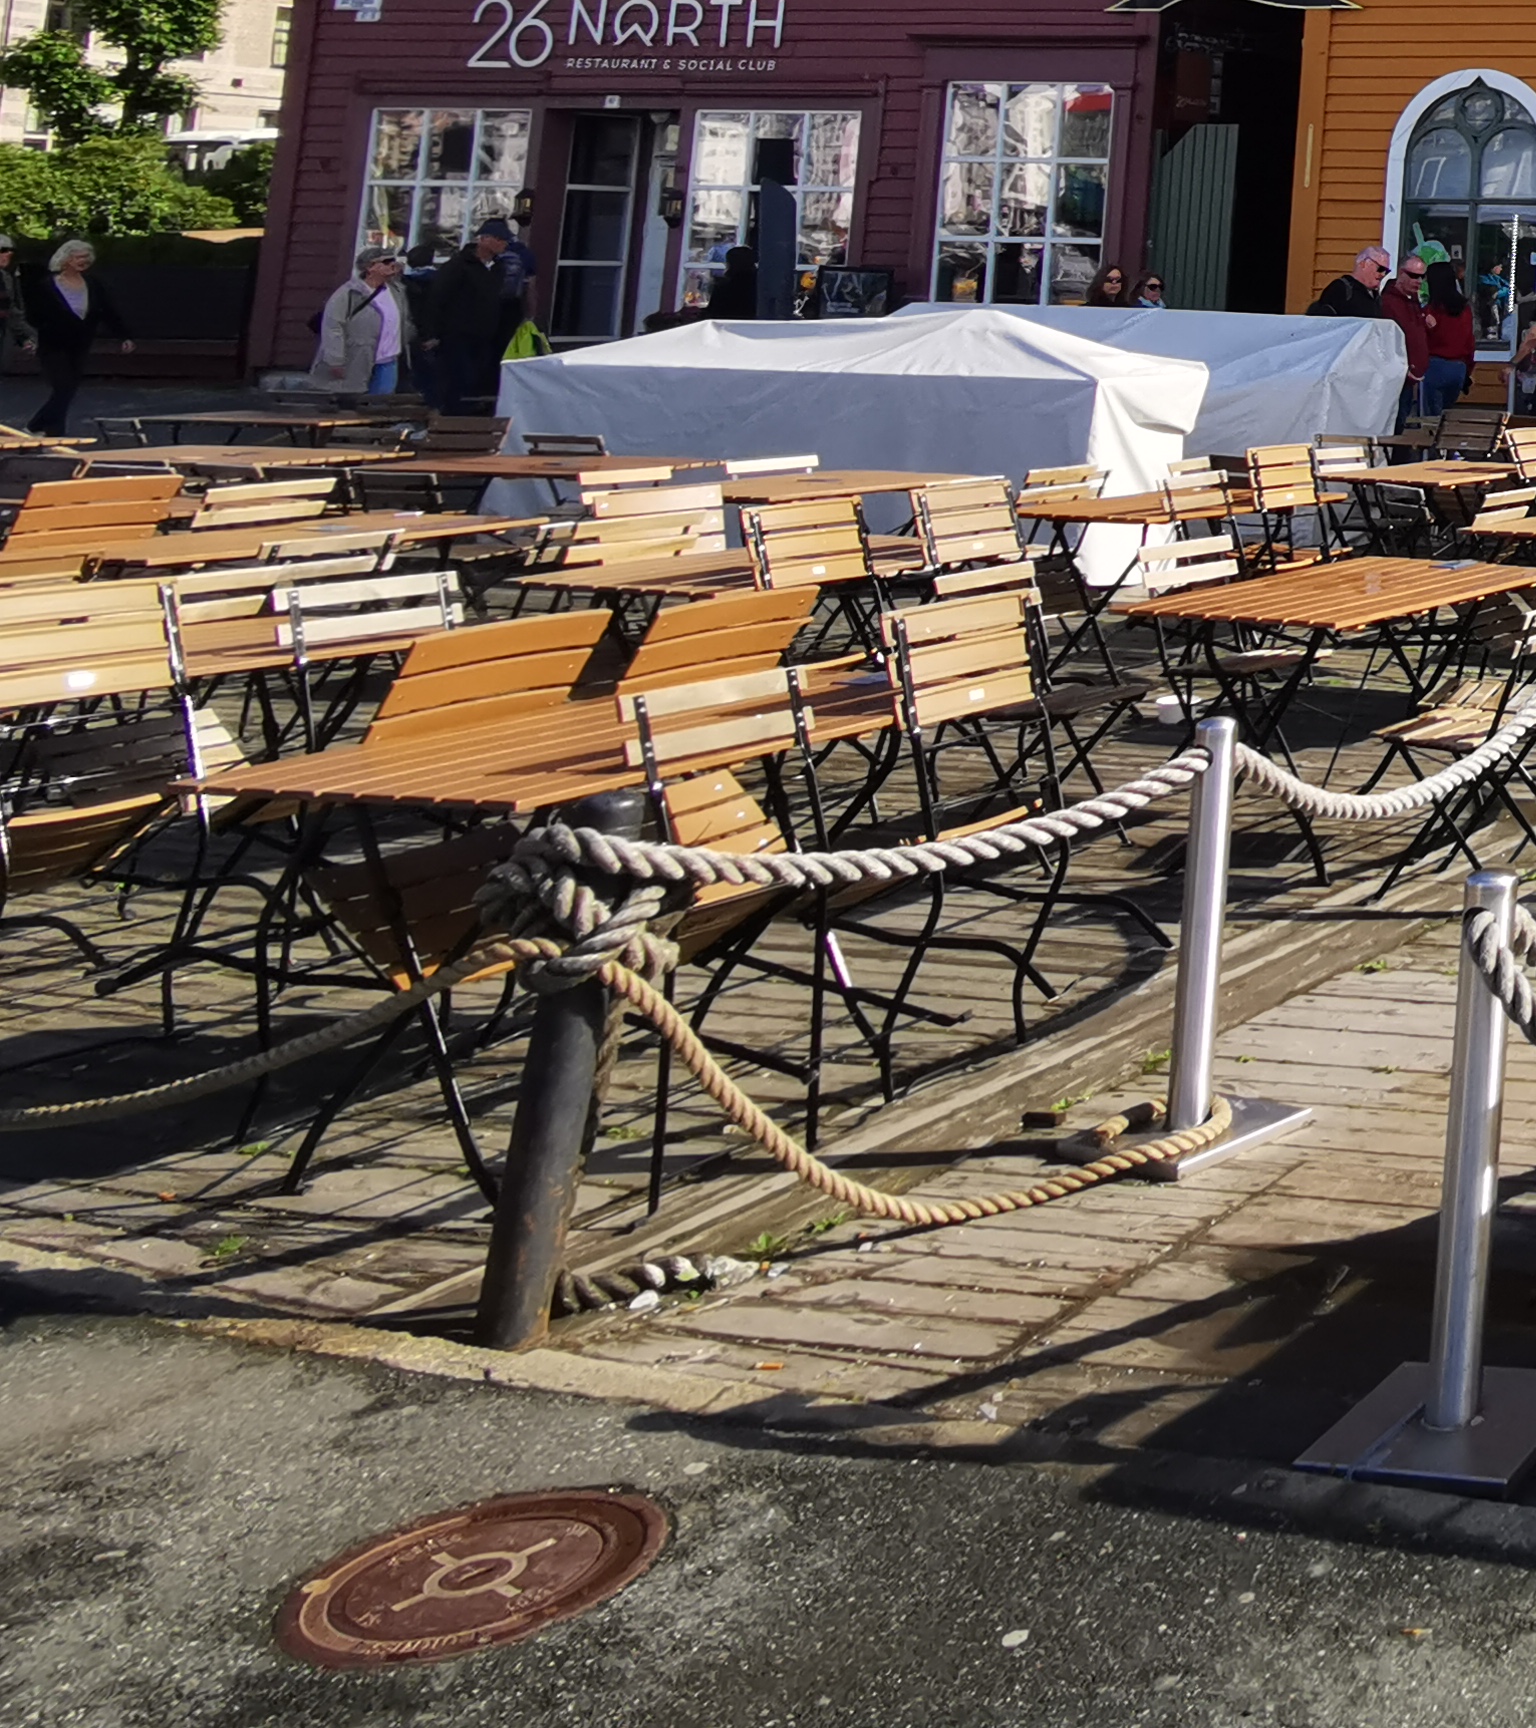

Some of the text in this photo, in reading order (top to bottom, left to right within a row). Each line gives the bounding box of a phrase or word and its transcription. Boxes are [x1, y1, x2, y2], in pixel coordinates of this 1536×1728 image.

[566, 58, 657, 69] RESTAURANT
[678, 59, 733, 71] SOCIAL
[738, 60, 777, 71] CLUB
